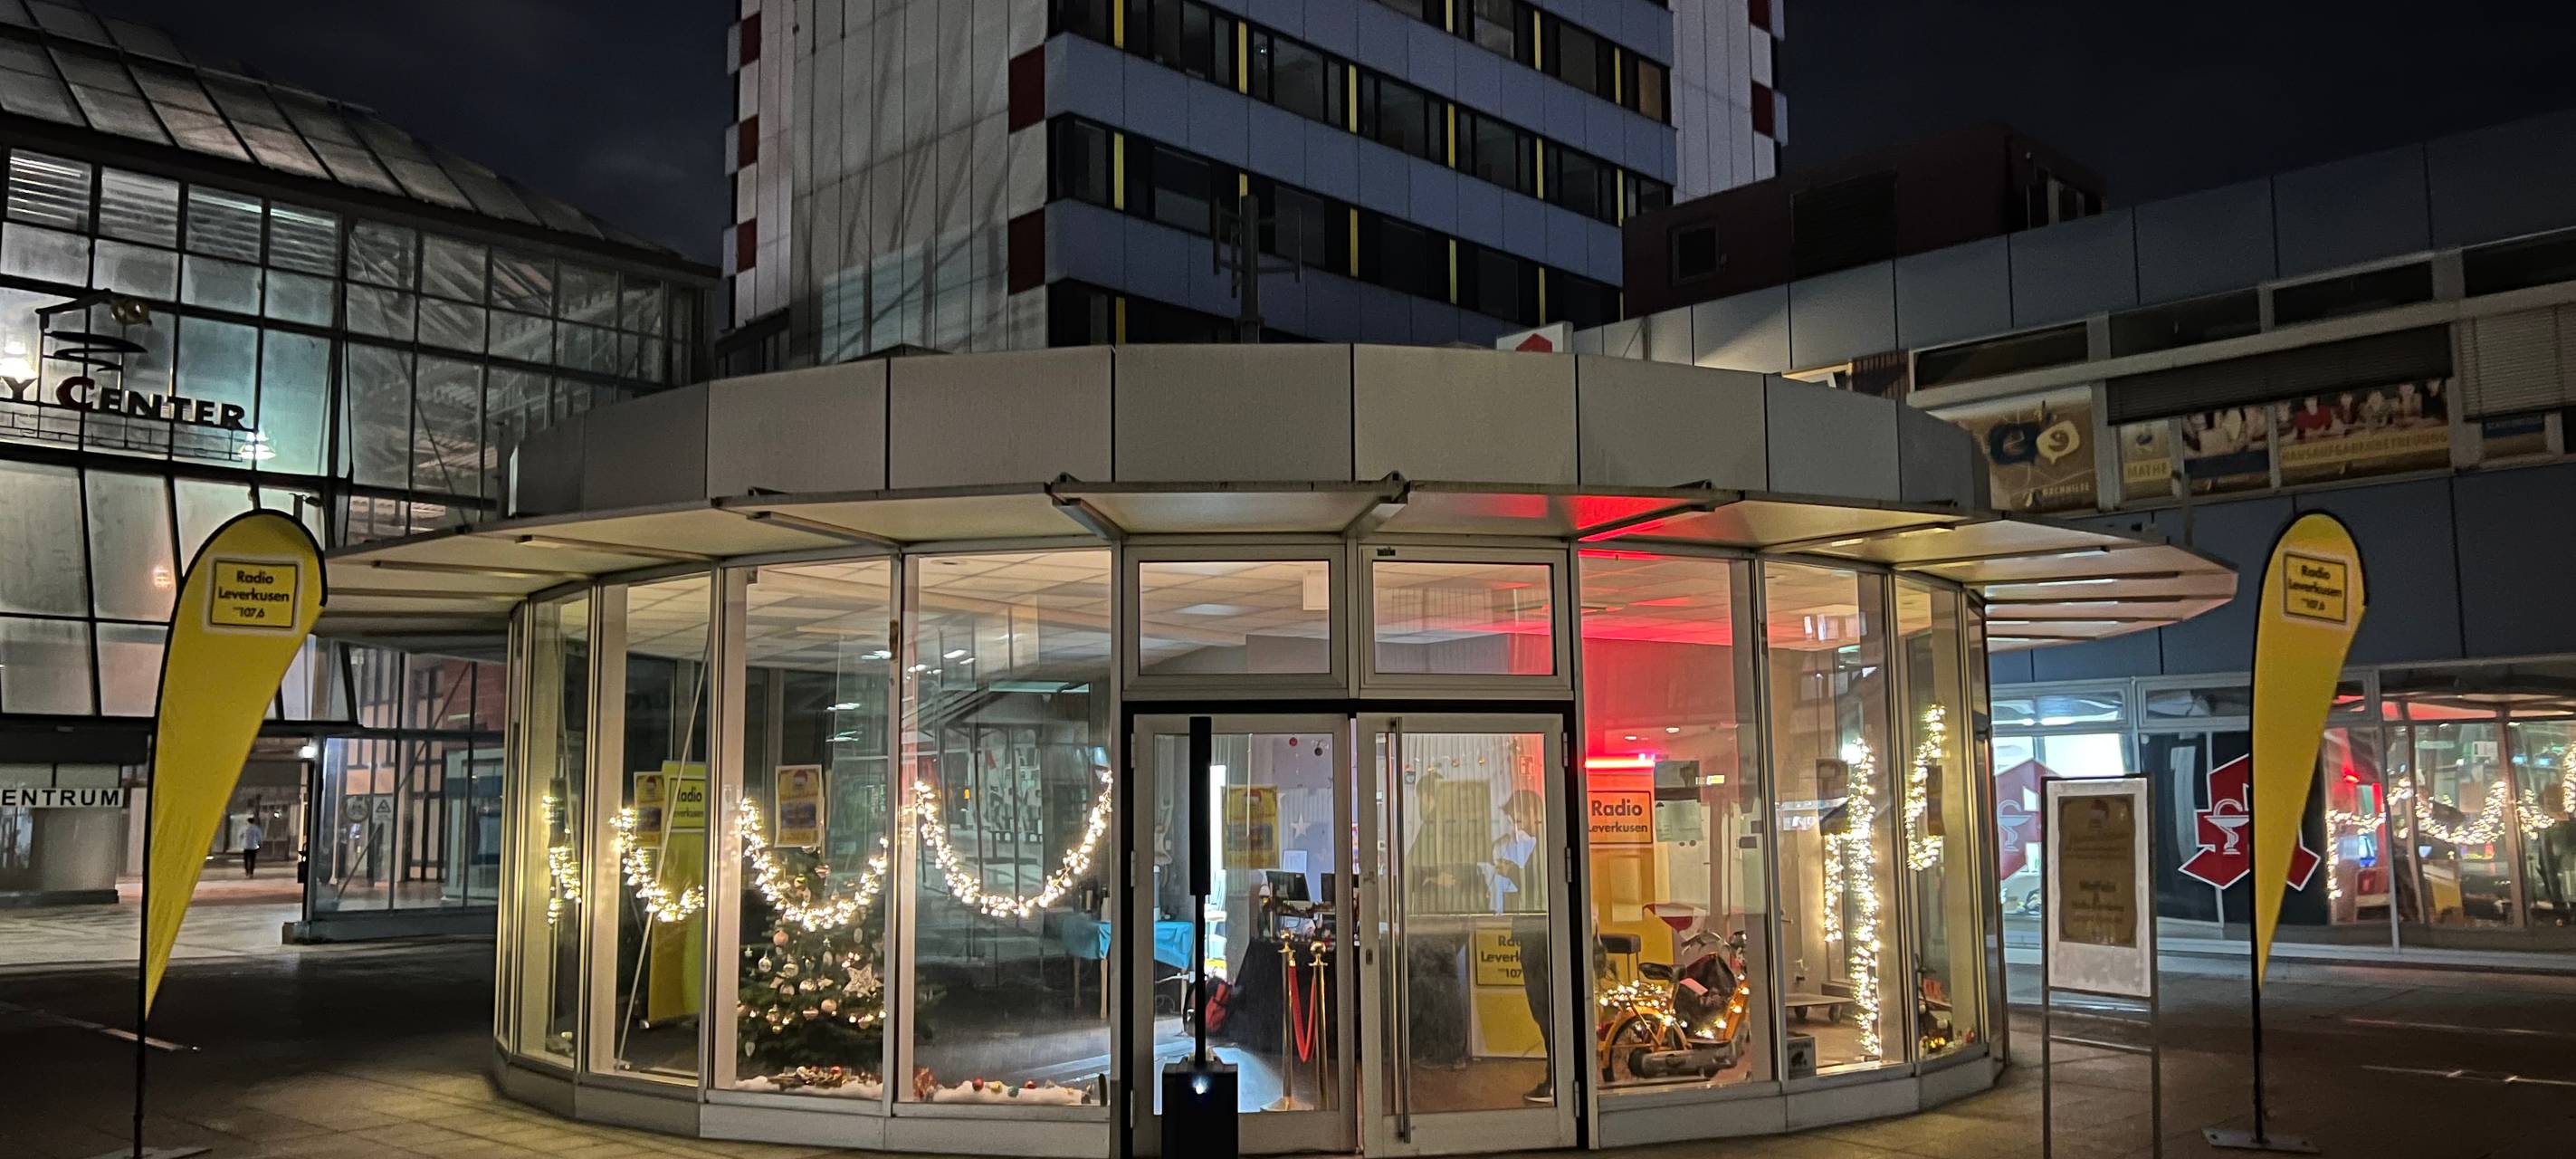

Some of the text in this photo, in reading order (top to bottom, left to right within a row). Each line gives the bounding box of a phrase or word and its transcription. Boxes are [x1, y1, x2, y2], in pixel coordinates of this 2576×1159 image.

[56, 376, 253, 431] CENTER
[236, 570, 274, 584] Radio
[218, 587, 290, 602] Leverkusen
[1, 789, 119, 806] ENTRUM
[677, 786, 702, 802] adio
[1591, 799, 1643, 817] Radio
